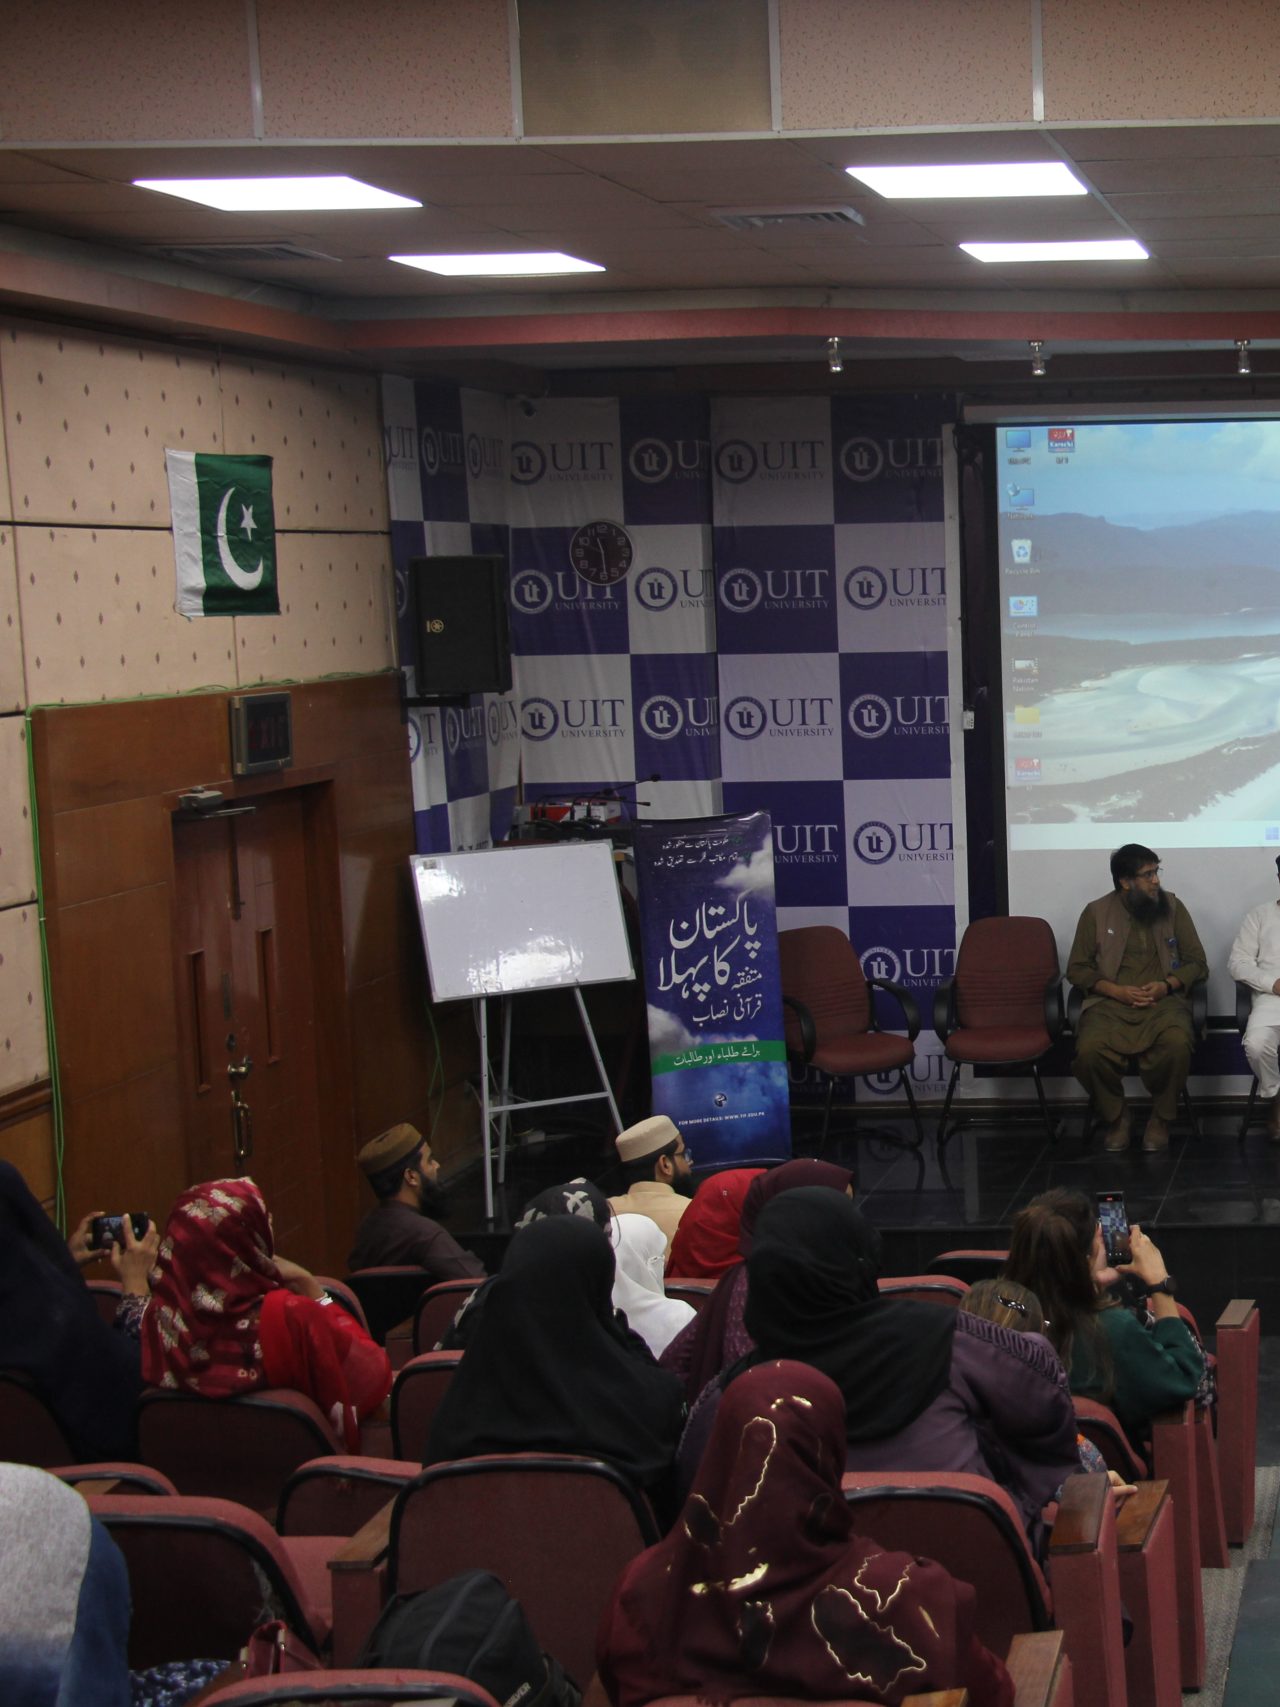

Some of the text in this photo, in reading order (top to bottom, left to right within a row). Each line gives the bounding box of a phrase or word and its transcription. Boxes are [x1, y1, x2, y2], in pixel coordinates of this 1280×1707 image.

[551, 442, 613, 471] UIT
[760, 441, 824, 470] UIT
[764, 570, 828, 598] UIT
[555, 602, 619, 610] UNIVERSITY
[764, 600, 828, 609] UNIVERSITY
[561, 700, 624, 727] UIT
[770, 699, 833, 726] UIT
[561, 730, 625, 738] UNIVERSITY
[769, 729, 833, 737] UNIVERSITY
[775, 825, 838, 853] UIT
[774, 855, 839, 863] UNIVERSITY
[669, 888, 762, 959] پاکستان
[657, 934, 741, 1002] کا پہلا
[731, 966, 762, 990] متفقہ
[692, 993, 762, 1027] قرآنی نصاب
[673, 1050, 703, 1066] طالبات
[703, 1049, 715, 1064] اور
